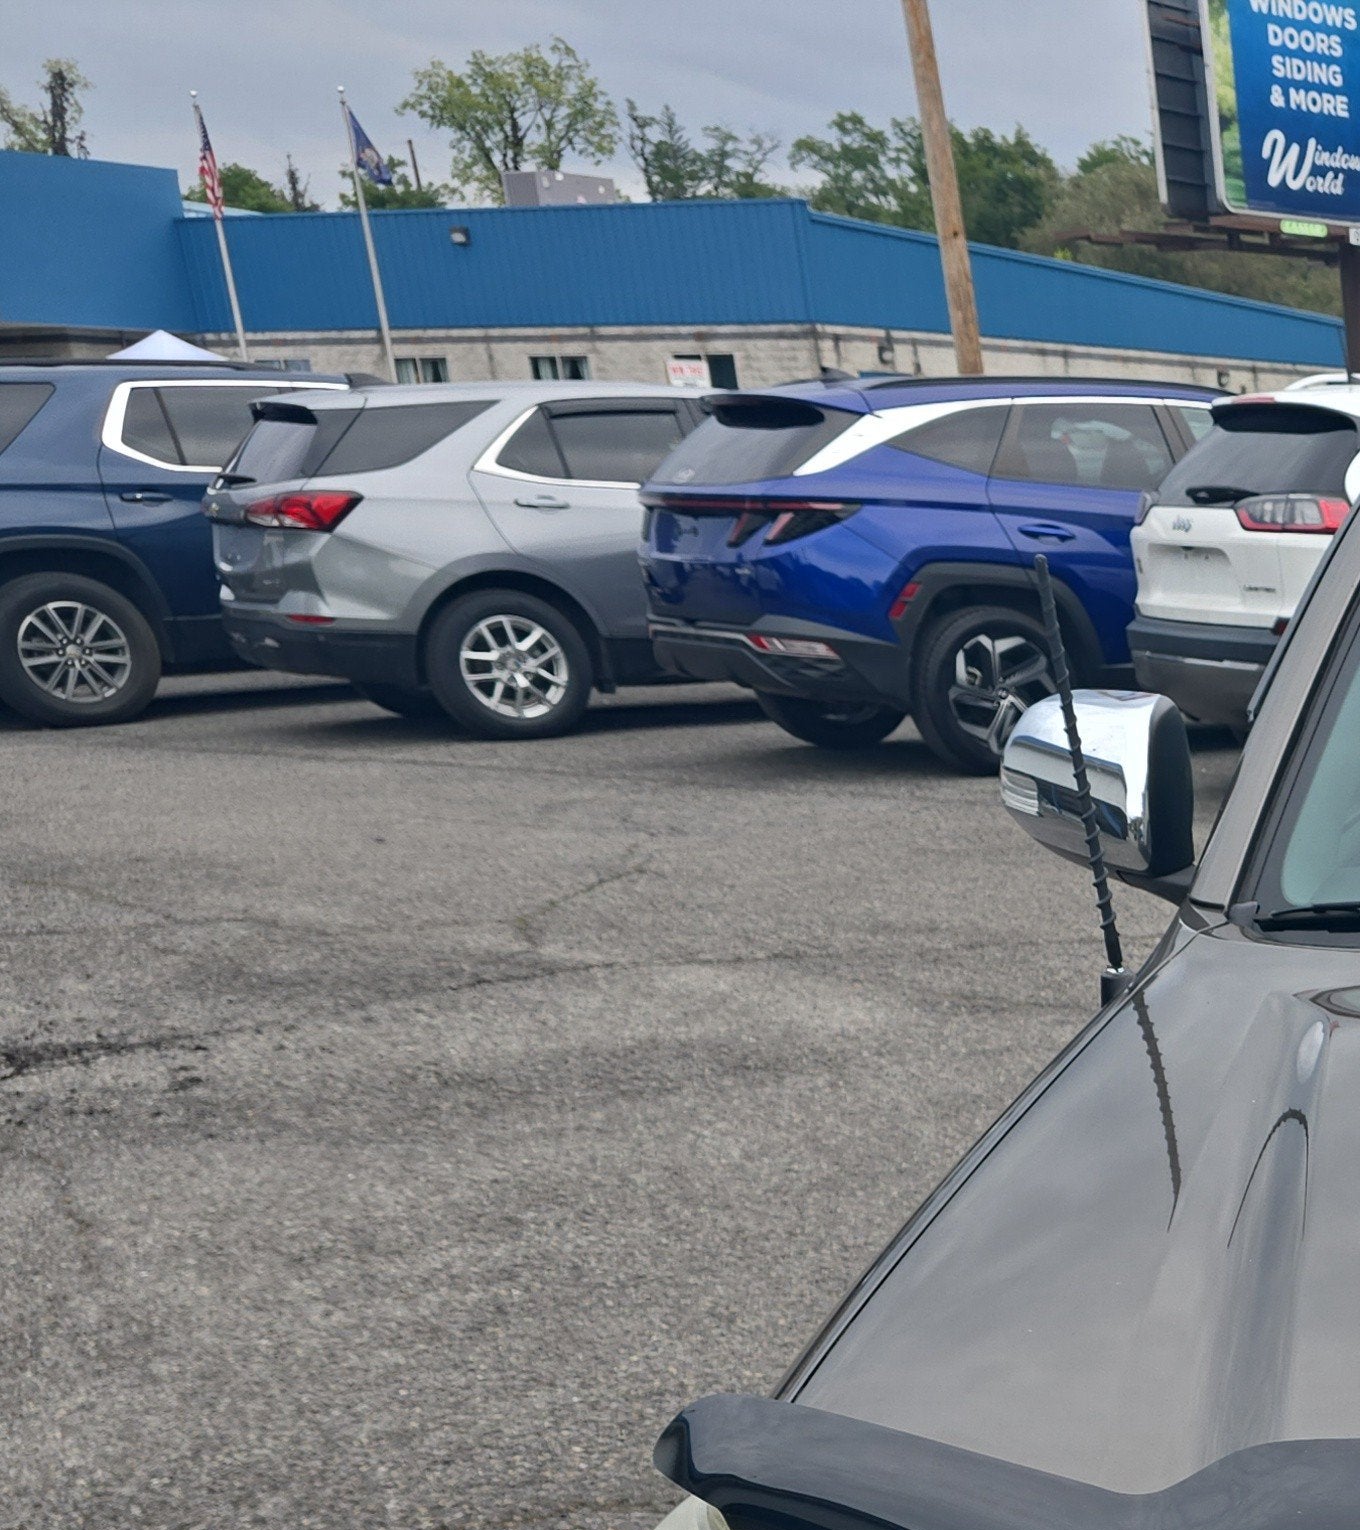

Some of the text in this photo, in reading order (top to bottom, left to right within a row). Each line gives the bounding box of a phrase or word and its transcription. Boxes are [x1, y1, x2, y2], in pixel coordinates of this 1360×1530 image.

[1250, 0, 1358, 30] WINDOWS
[1267, 23, 1343, 58] DOORS
[1271, 55, 1344, 88] SIDING
[1270, 84, 1350, 118] & MORE
